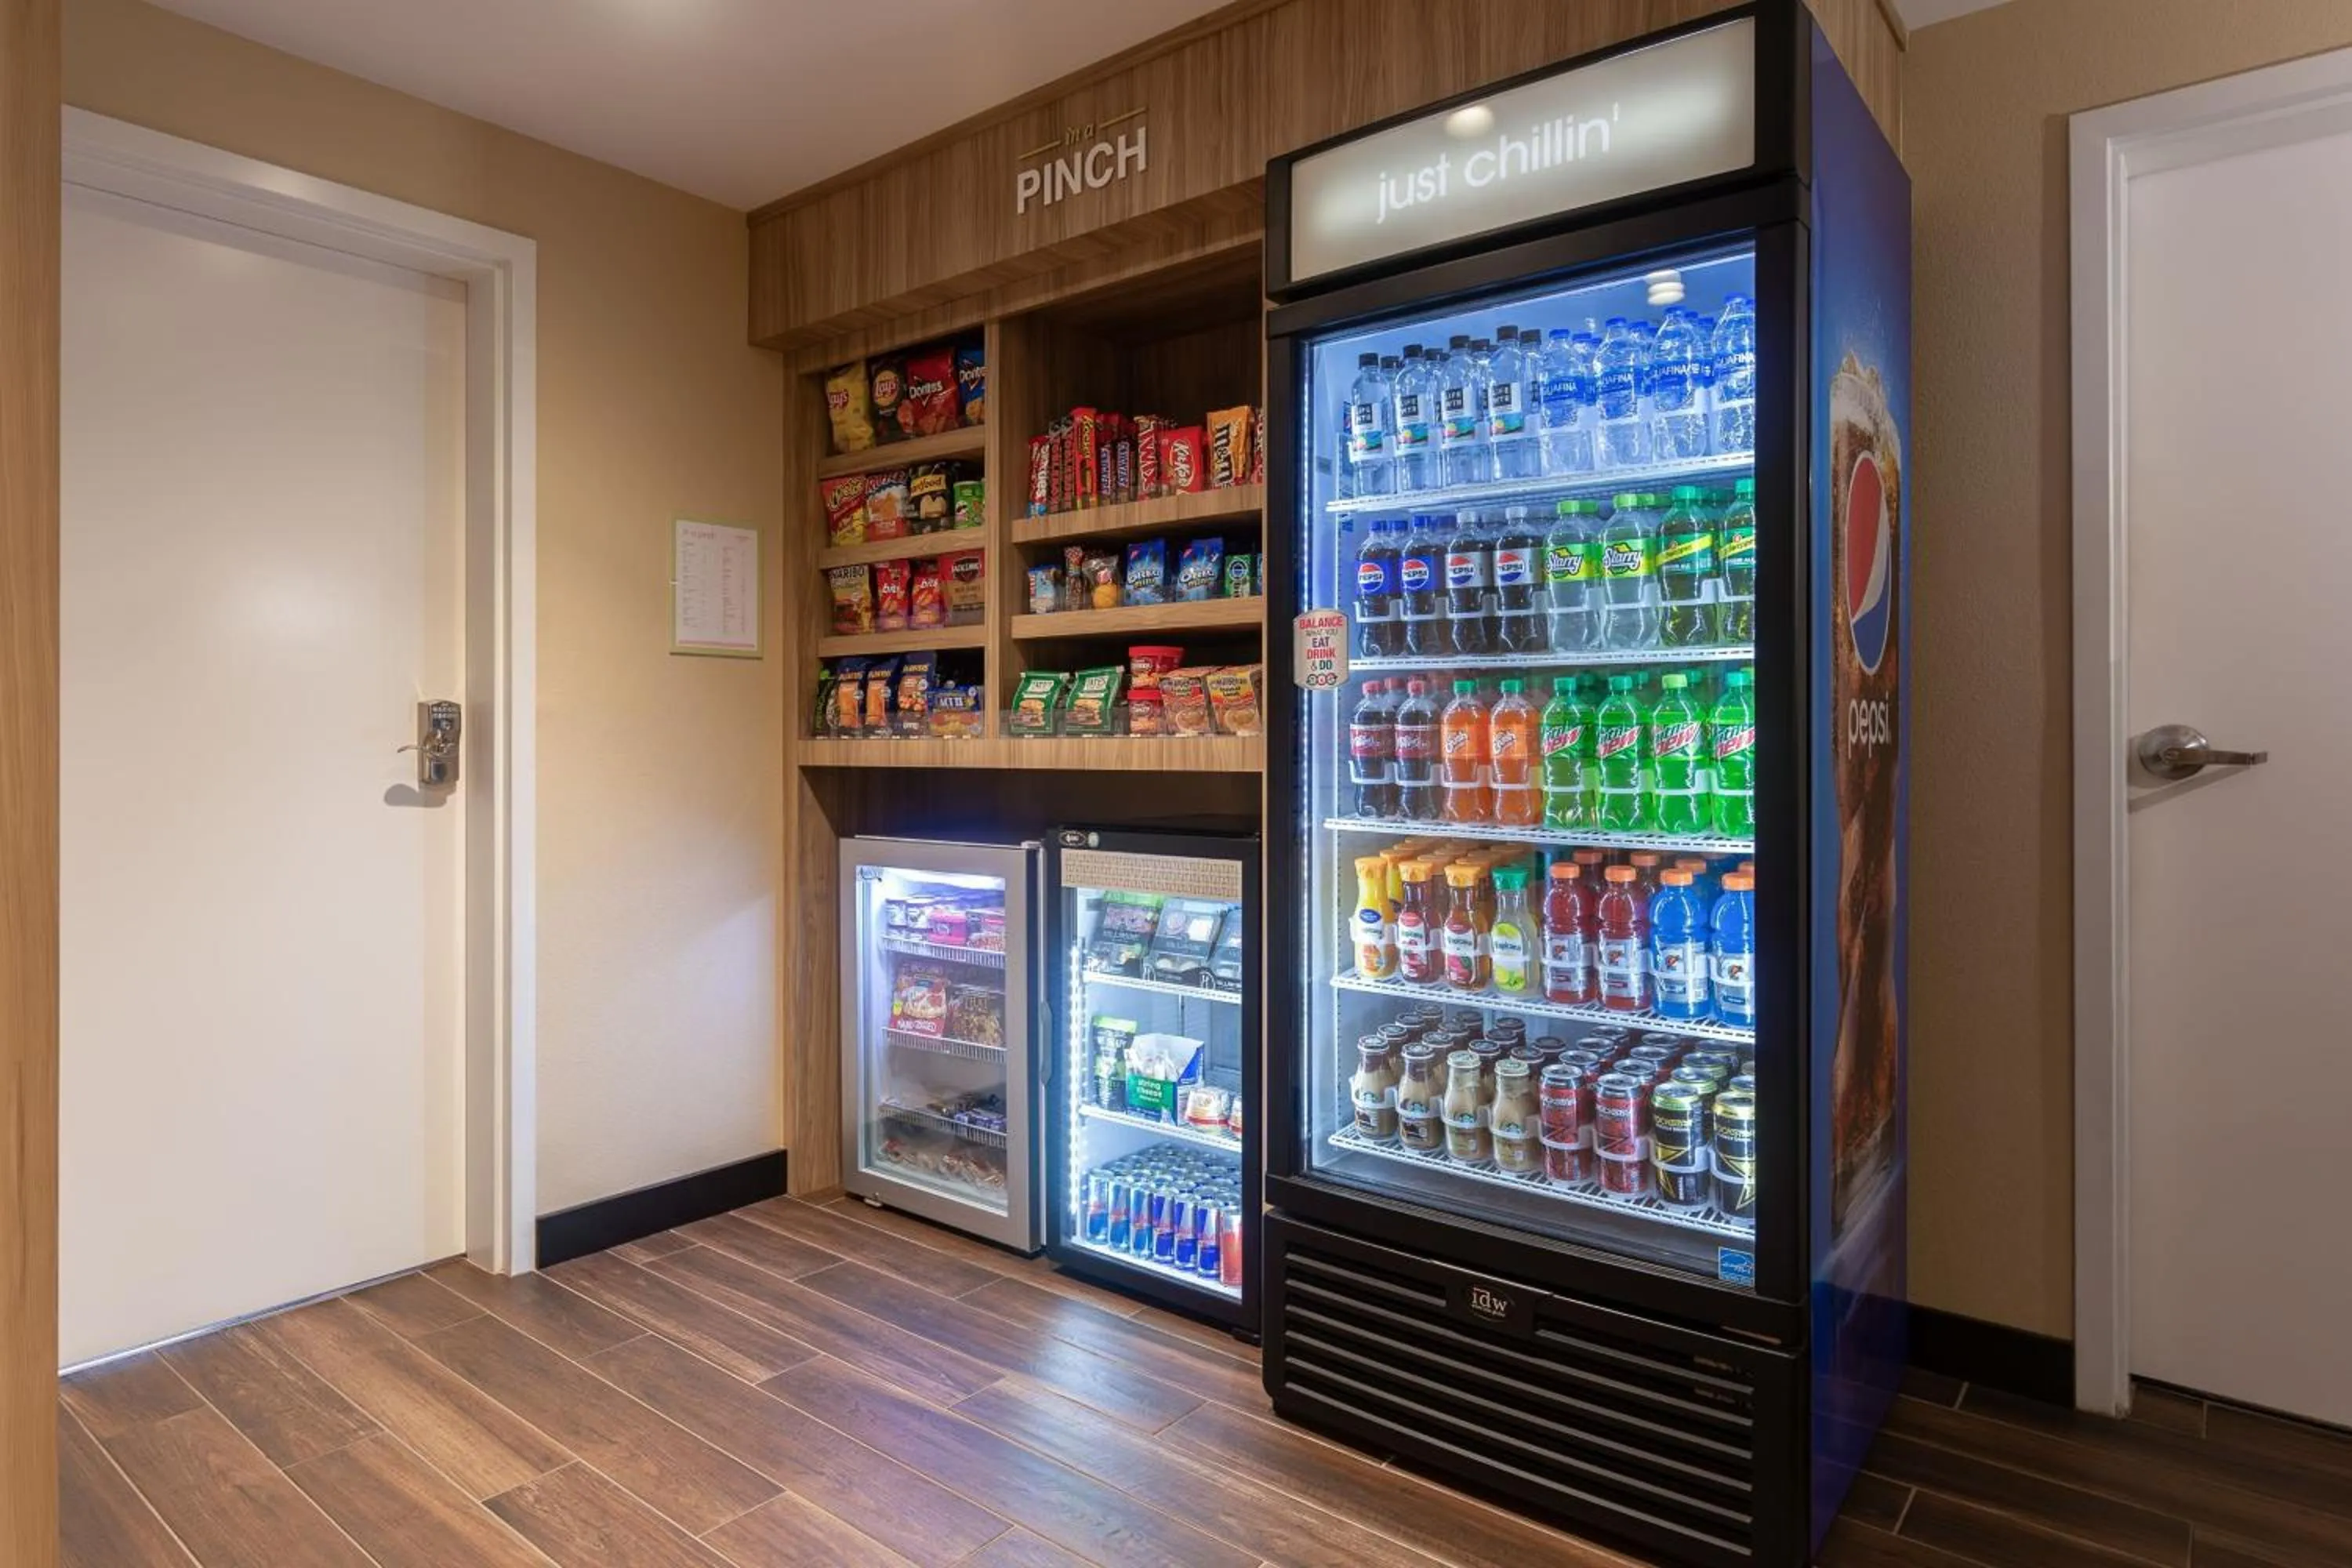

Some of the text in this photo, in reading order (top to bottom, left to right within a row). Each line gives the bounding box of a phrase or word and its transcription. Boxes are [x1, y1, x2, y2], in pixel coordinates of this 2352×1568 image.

[1017, 125, 1146, 214] PINCH
[1375, 101, 1621, 223] just chillin'
[959, 366, 987, 383] Dorit
[909, 379, 943, 399] Doritos
[1548, 550, 1583, 573] Starry
[1603, 547, 1642, 570] Starry
[1298, 616, 1343, 630] BALANCE
[1312, 637, 1330, 648] EAT
[1307, 648, 1336, 659] DRINK
[1319, 659, 1332, 670] DO
[1847, 691, 1890, 759] pepsi
